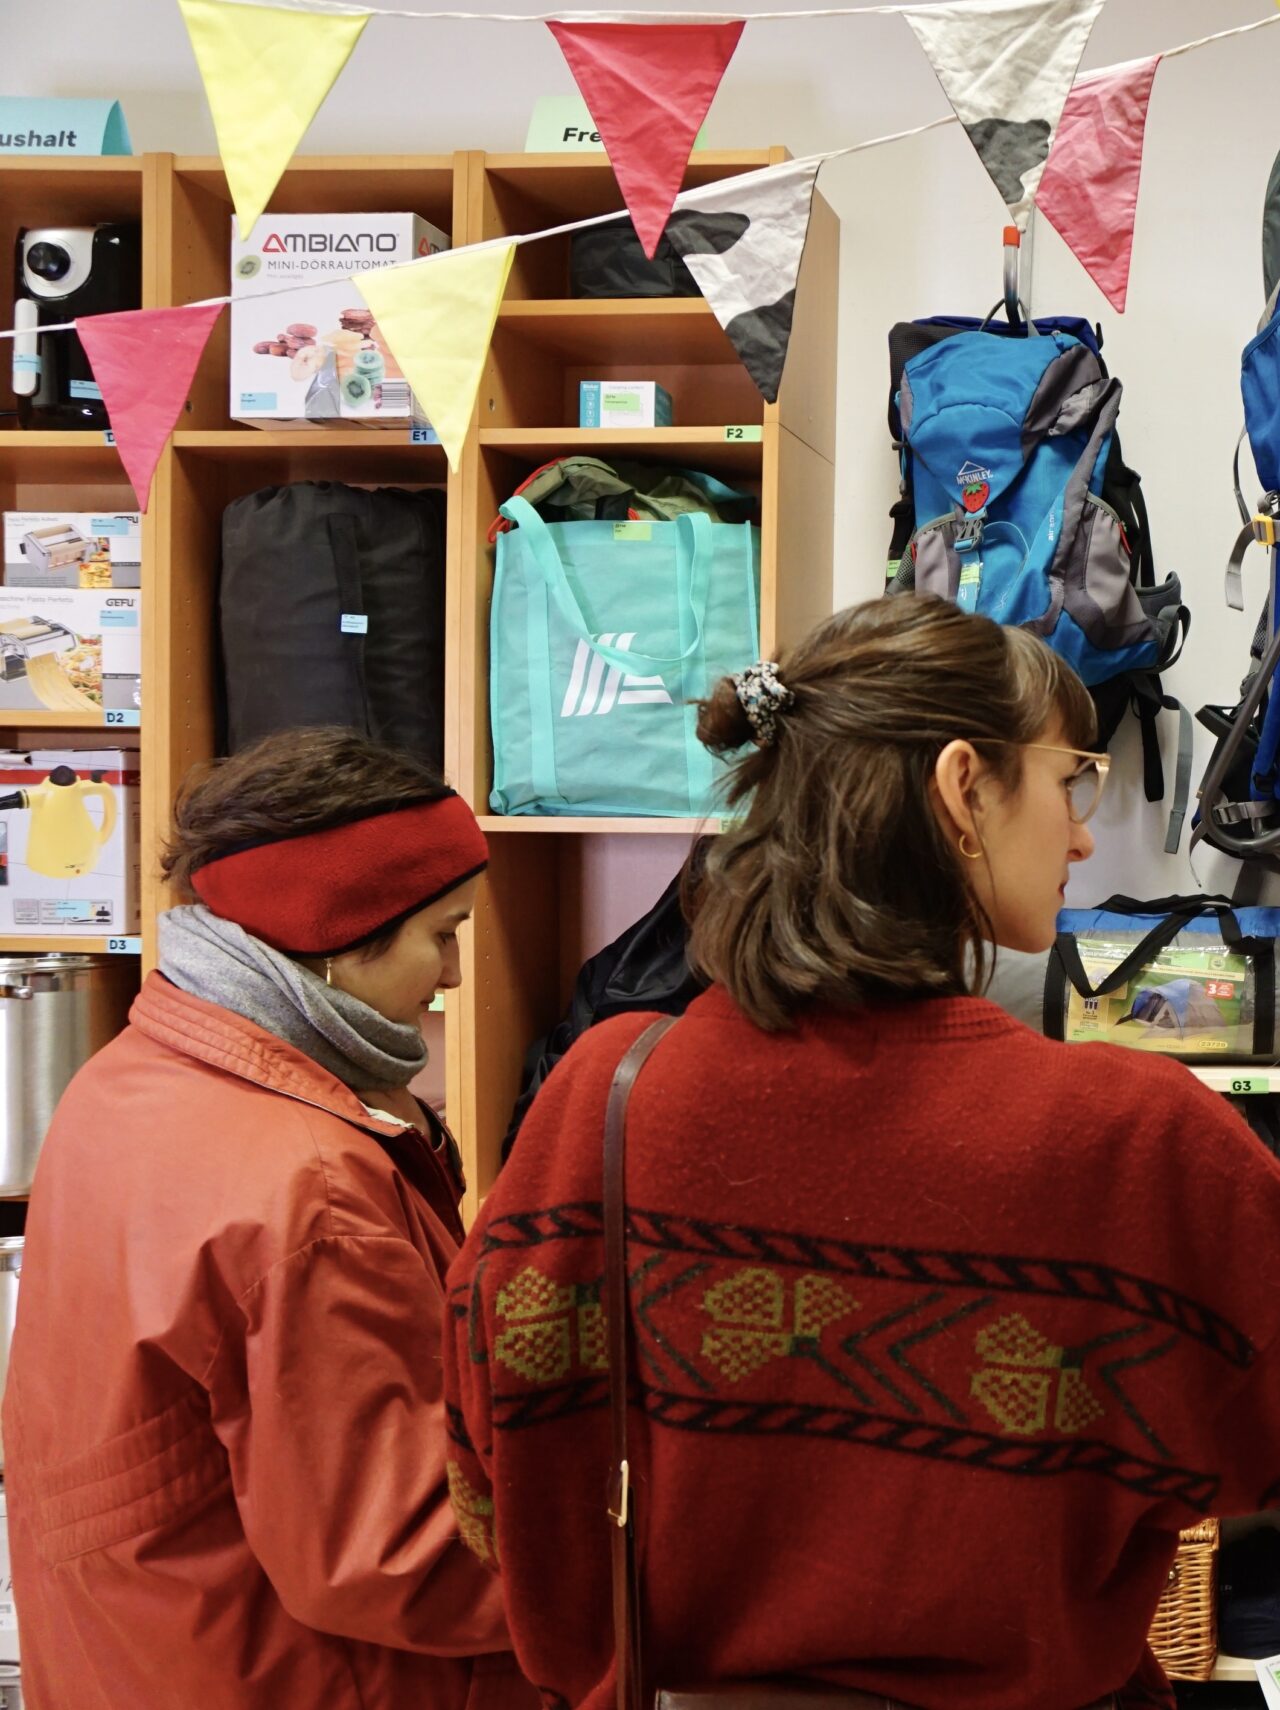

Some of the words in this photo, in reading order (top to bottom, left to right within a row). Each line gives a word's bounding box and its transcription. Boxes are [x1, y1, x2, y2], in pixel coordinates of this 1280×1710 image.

[562, 127, 602, 143] Fre
[262, 233, 397, 252] AMBIANO
[413, 431, 427, 441] E1
[727, 428, 743, 439] F2
[106, 598, 135, 607] GEFU
[106, 712, 124, 723] D2
[109, 940, 126, 950] D3
[1208, 983, 1217, 995] 3
[1232, 1080, 1252, 1092] G3
